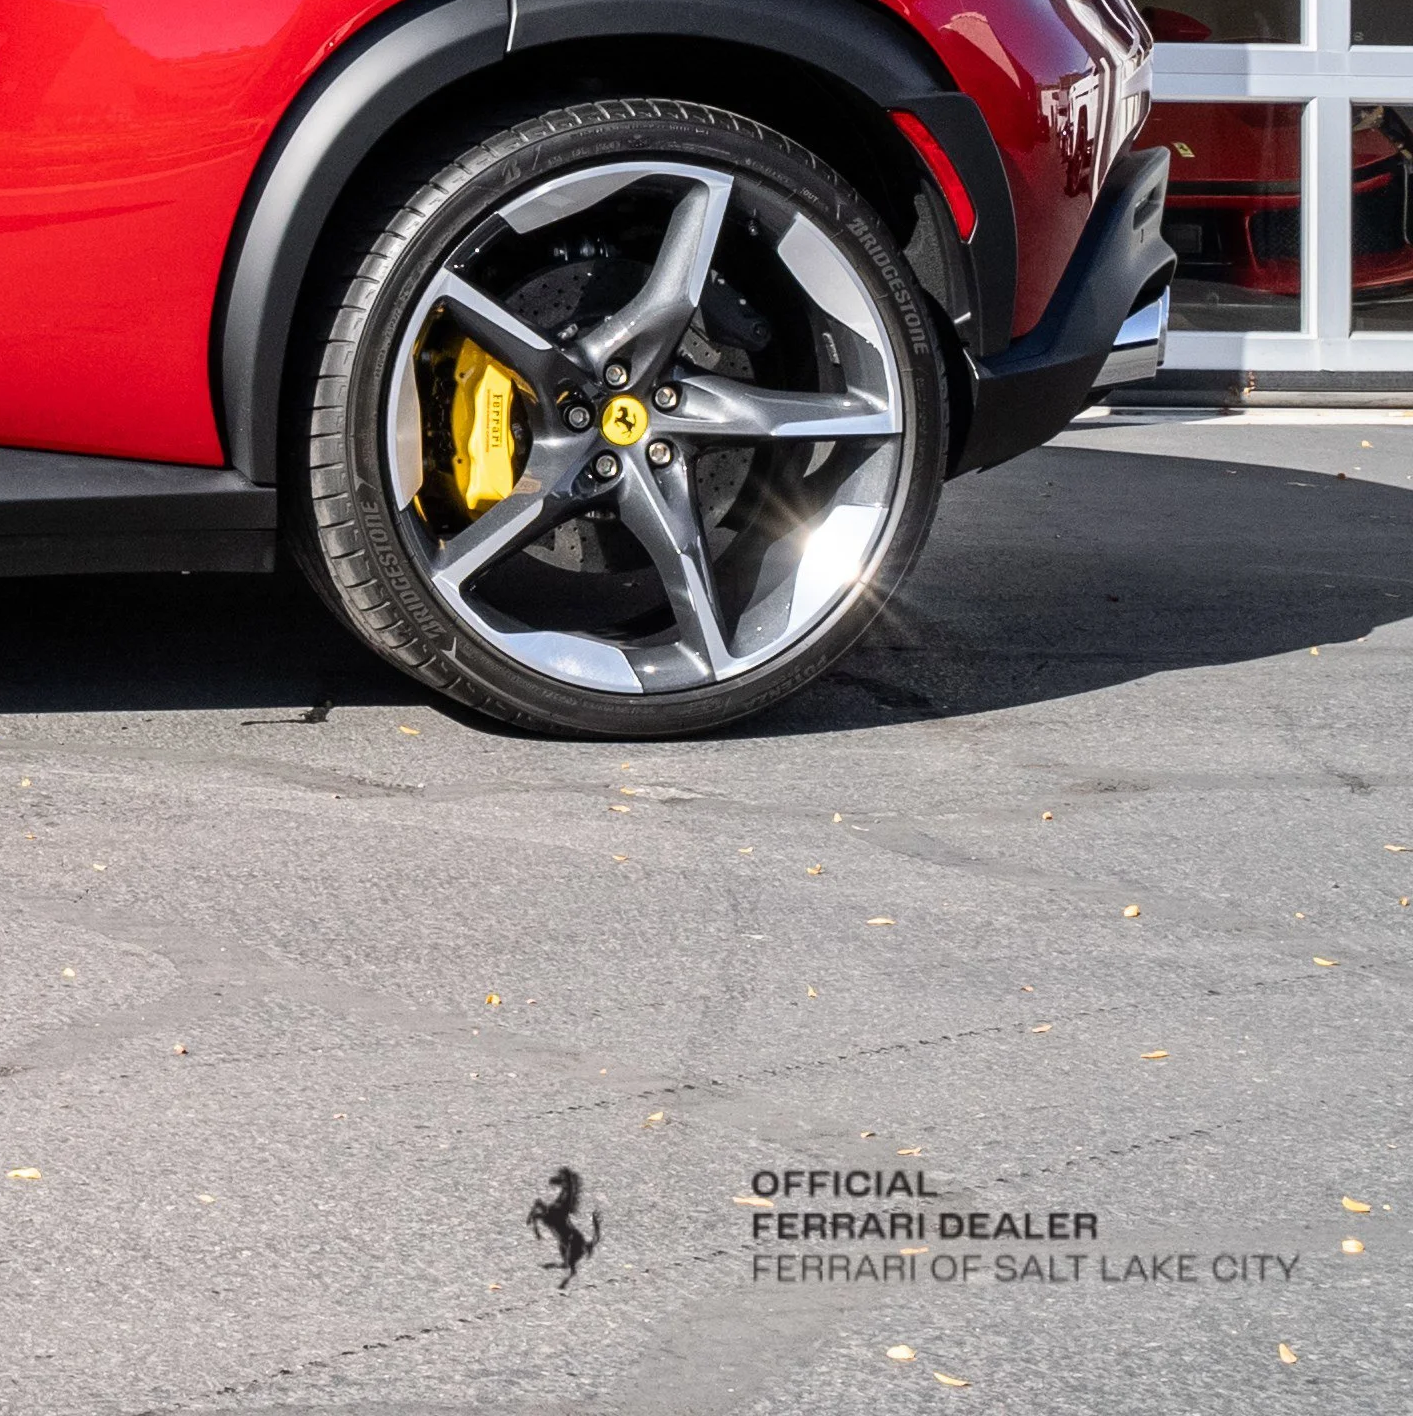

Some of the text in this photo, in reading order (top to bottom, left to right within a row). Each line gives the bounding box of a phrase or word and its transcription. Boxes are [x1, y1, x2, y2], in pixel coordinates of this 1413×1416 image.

[846, 216, 931, 356] BRIDGESTONE
[491, 393, 503, 449] Ferrari
[360, 500, 448, 640] BRIDGESTONE
